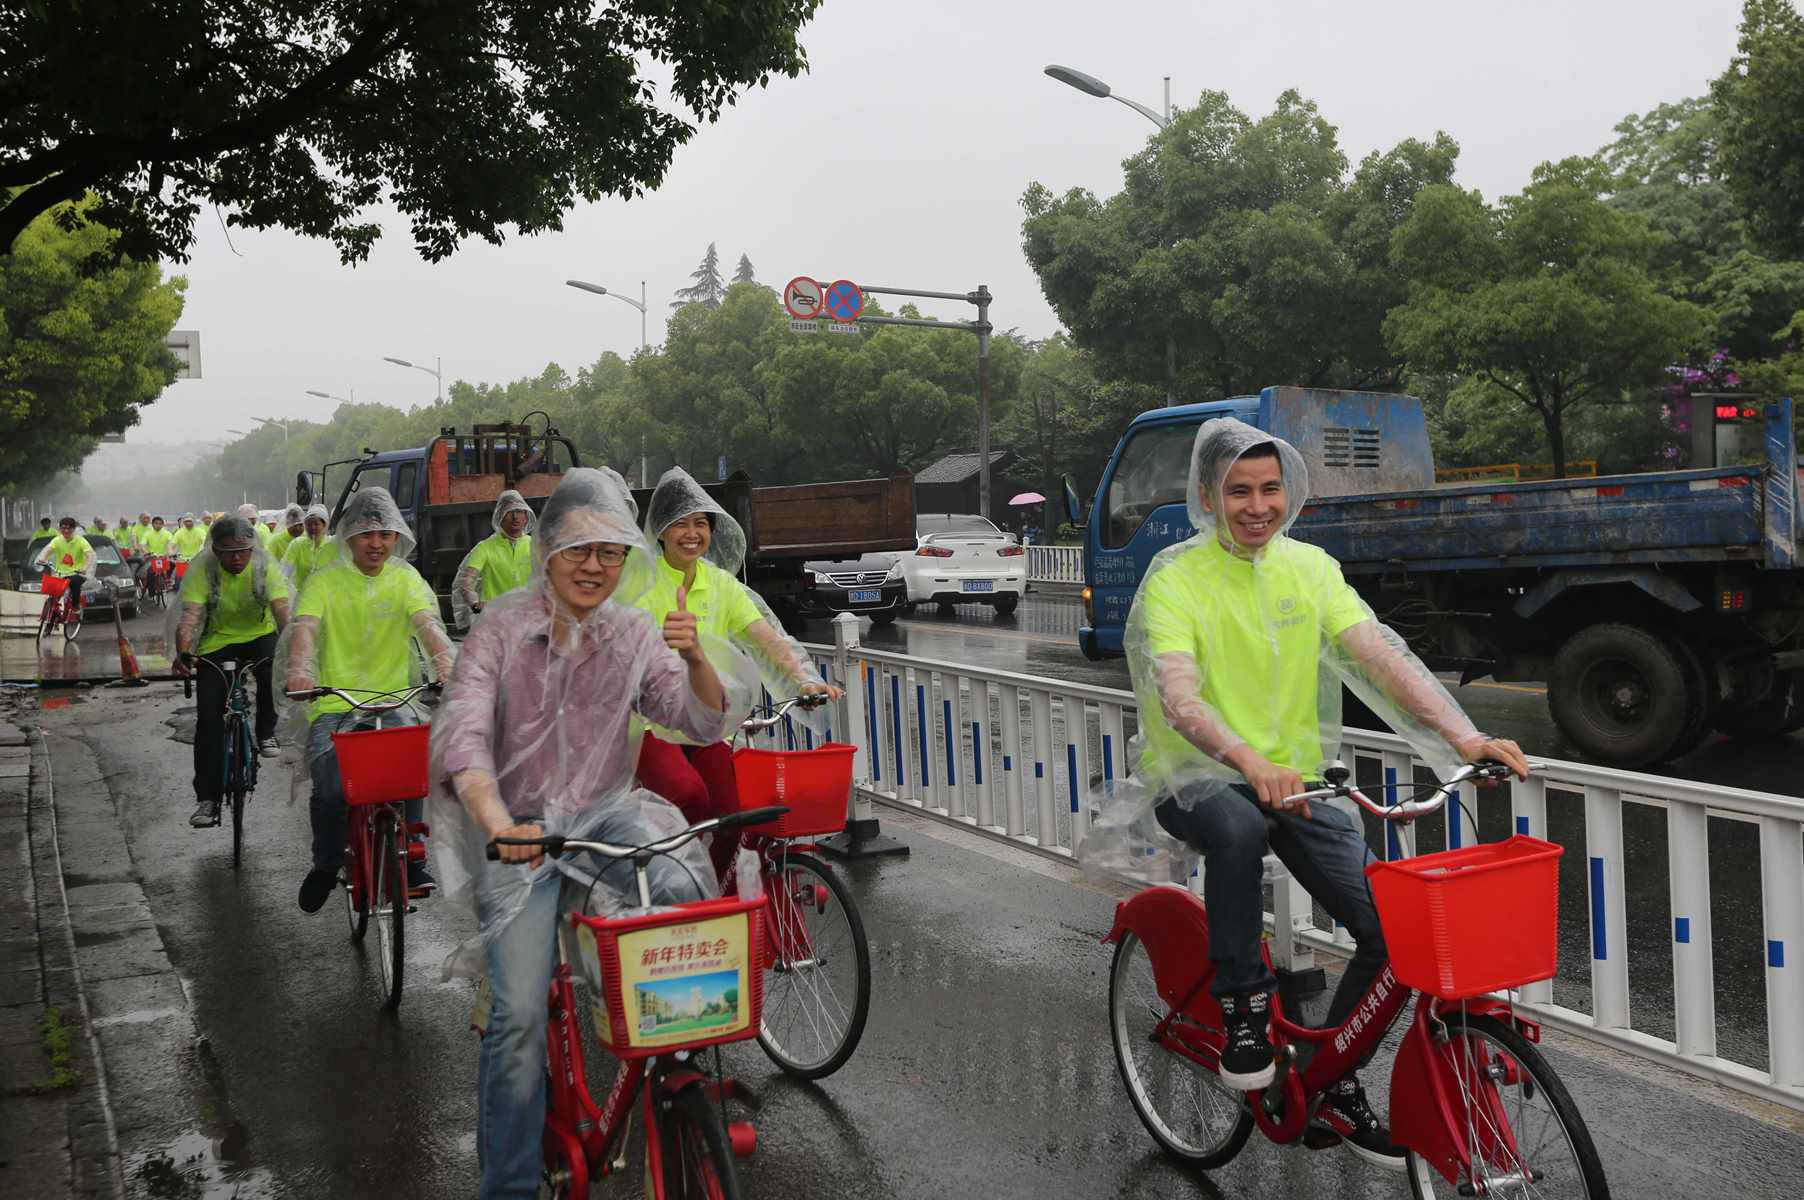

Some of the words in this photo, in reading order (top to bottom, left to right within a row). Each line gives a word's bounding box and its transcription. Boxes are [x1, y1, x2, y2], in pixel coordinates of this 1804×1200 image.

[640, 938, 729, 966] 新年特卖会
[1334, 966, 1396, 1054] 绍兴市公共自行
